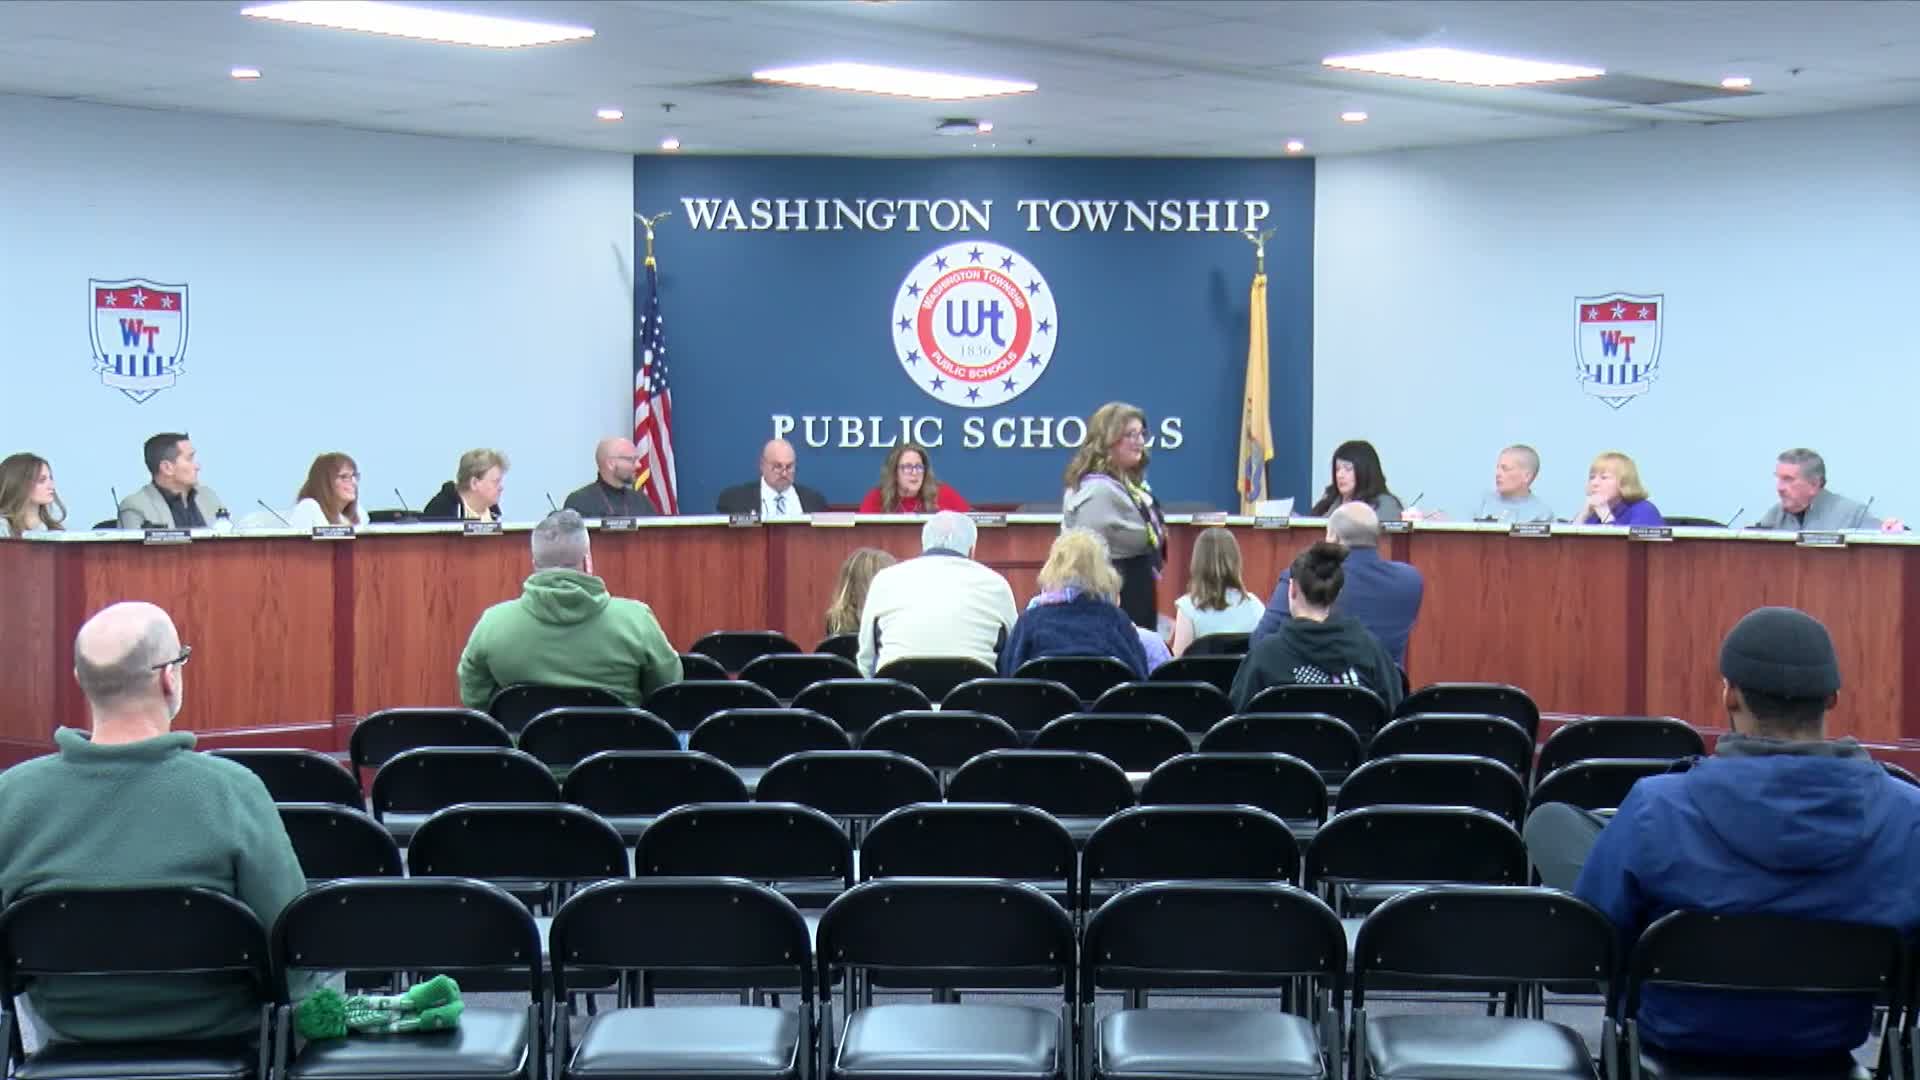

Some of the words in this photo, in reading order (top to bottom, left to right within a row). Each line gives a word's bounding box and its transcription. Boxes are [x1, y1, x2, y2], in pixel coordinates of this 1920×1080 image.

[680, 198, 993, 231] WASHINGTON
[1017, 199, 1271, 232] TOWNSHIP
[922, 269, 980, 309] WASHINGTON
[983, 269, 1025, 309] TOWNSHIP
[119, 318, 160, 353] WT
[1600, 329, 1636, 363] WT
[931, 351, 966, 377] PUBLIC
[968, 351, 1017, 380] SCHOOLS
[772, 414, 944, 448] PUBLIC
[963, 416, 1184, 449] SCHOS
